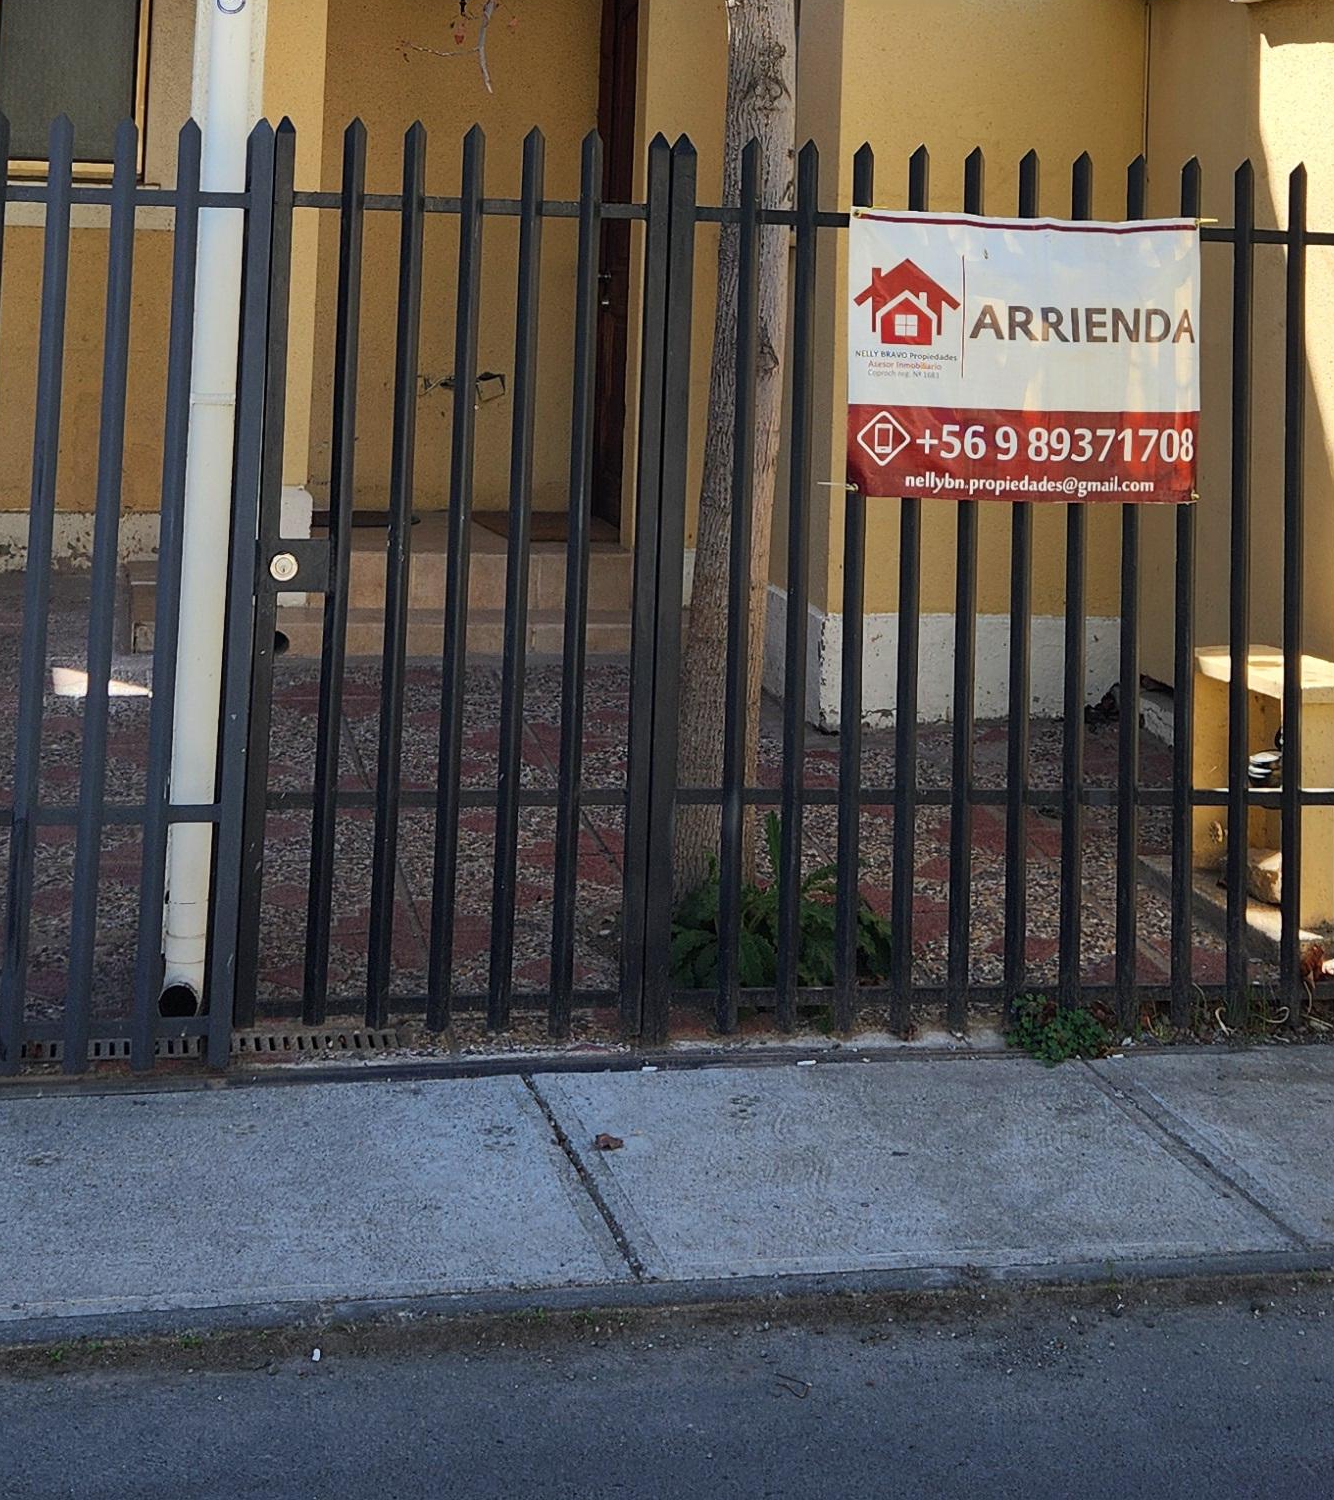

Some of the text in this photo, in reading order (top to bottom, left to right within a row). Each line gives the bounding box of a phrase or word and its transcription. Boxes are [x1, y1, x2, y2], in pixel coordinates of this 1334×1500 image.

[969, 304, 1195, 344] ARRIENDA
[855, 350, 957, 362] NELLY BRAVO Propiedades
[868, 360, 942, 371] Asesor Inmobiliario
[916, 424, 1194, 463] +56 9 89371708
[905, 471, 1154, 496] nellybn.propiedades@gmail.com
